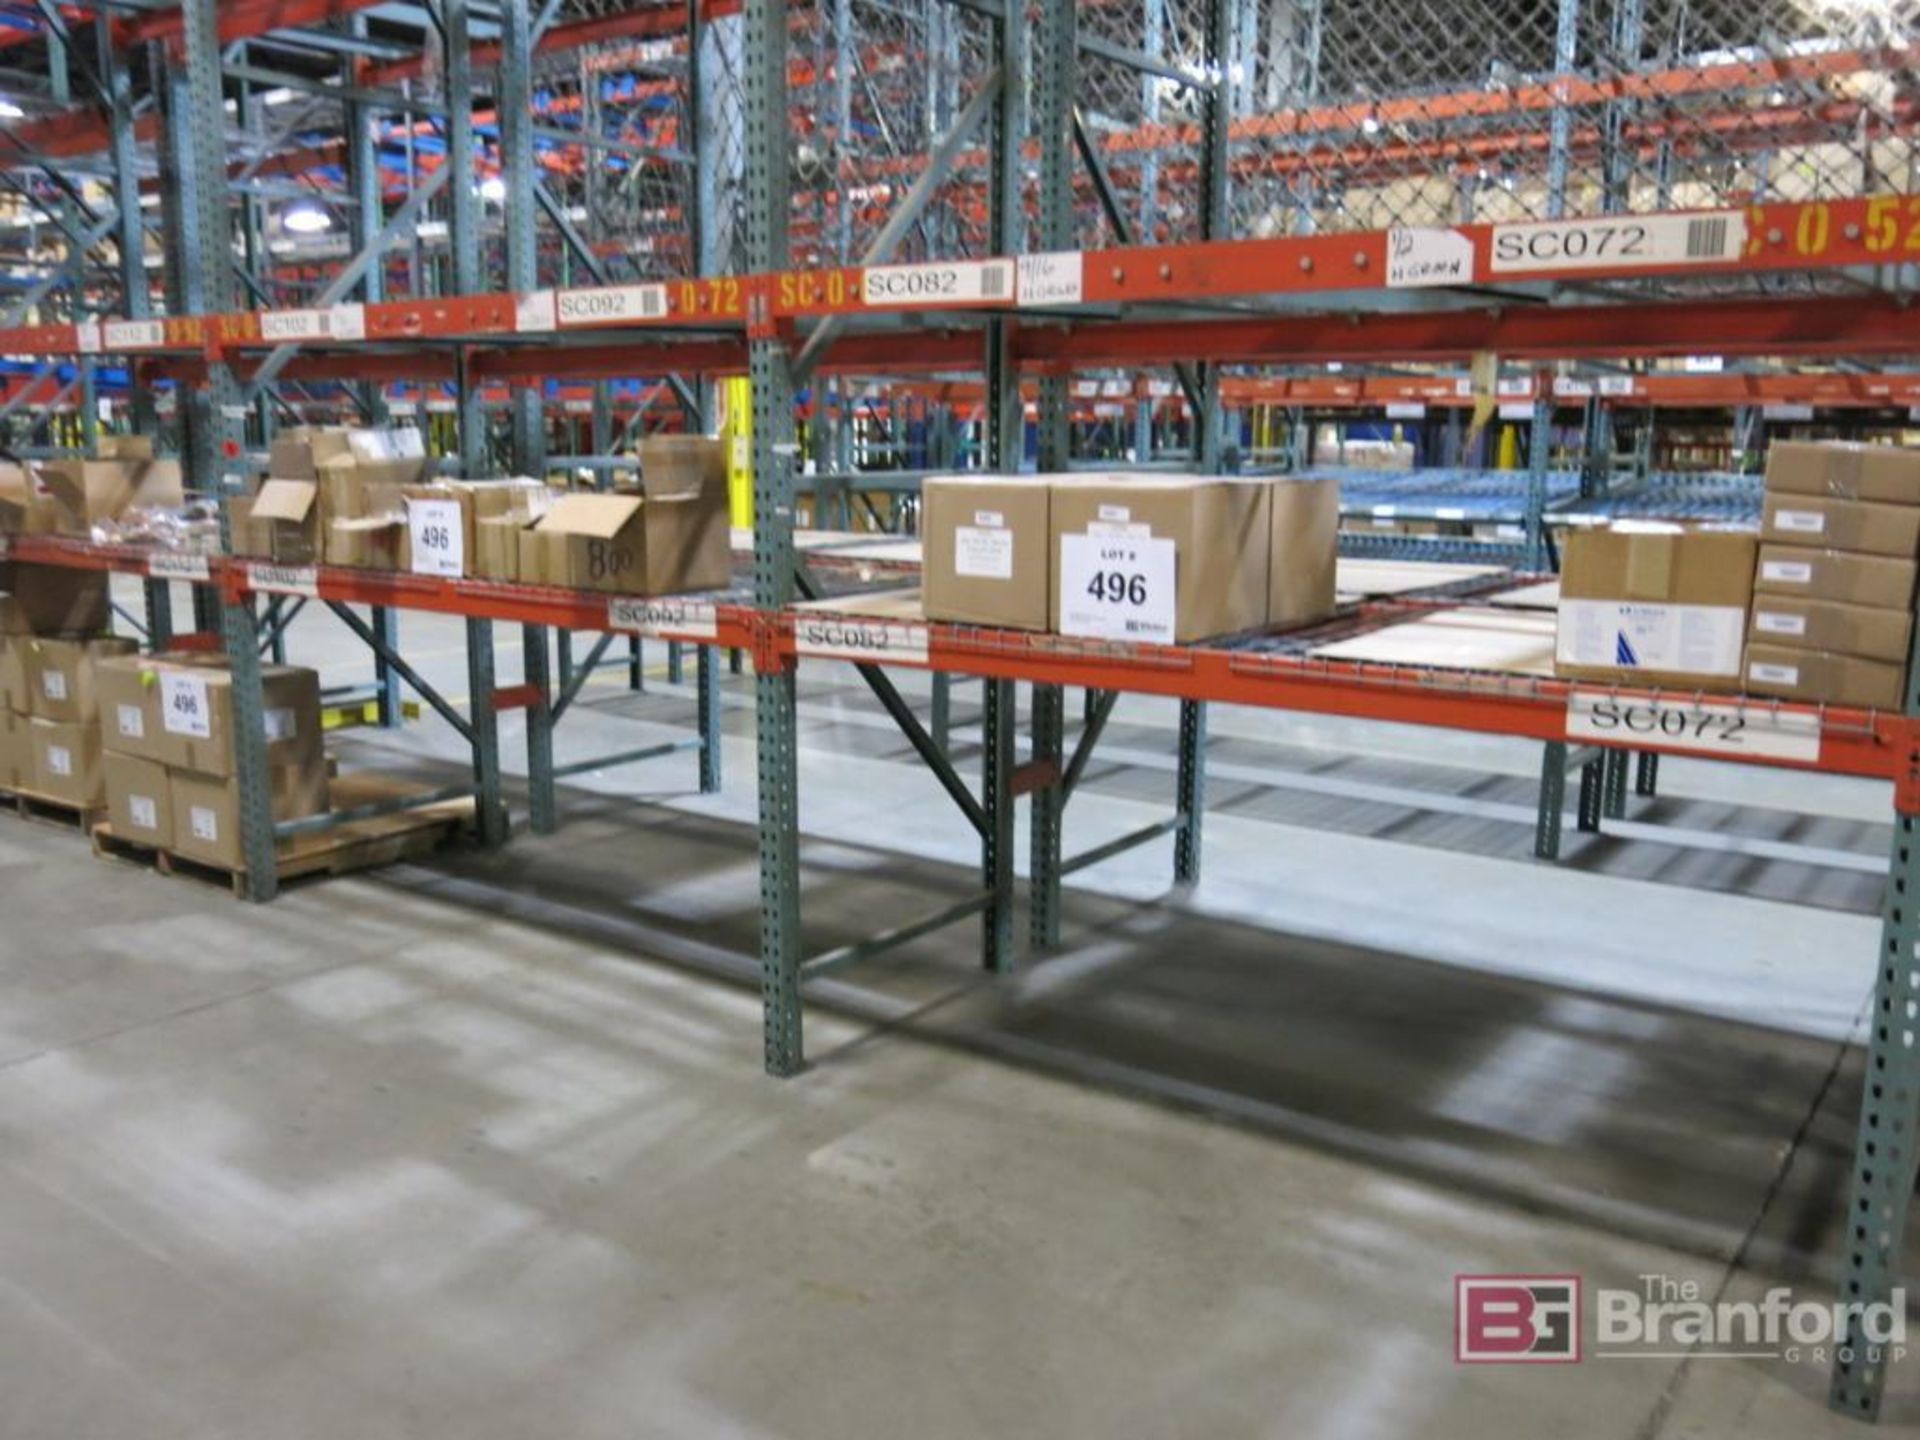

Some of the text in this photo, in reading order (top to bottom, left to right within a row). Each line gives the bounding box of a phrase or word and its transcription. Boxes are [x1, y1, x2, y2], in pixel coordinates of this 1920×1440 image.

[1496, 226, 1646, 261] SC072
[867, 271, 958, 296] SC082
[560, 293, 626, 316] SC092
[421, 525, 449, 551] 496
[1086, 570, 1147, 607] 496
[173, 693, 198, 715] 496
[1590, 702, 1746, 743] SC072
